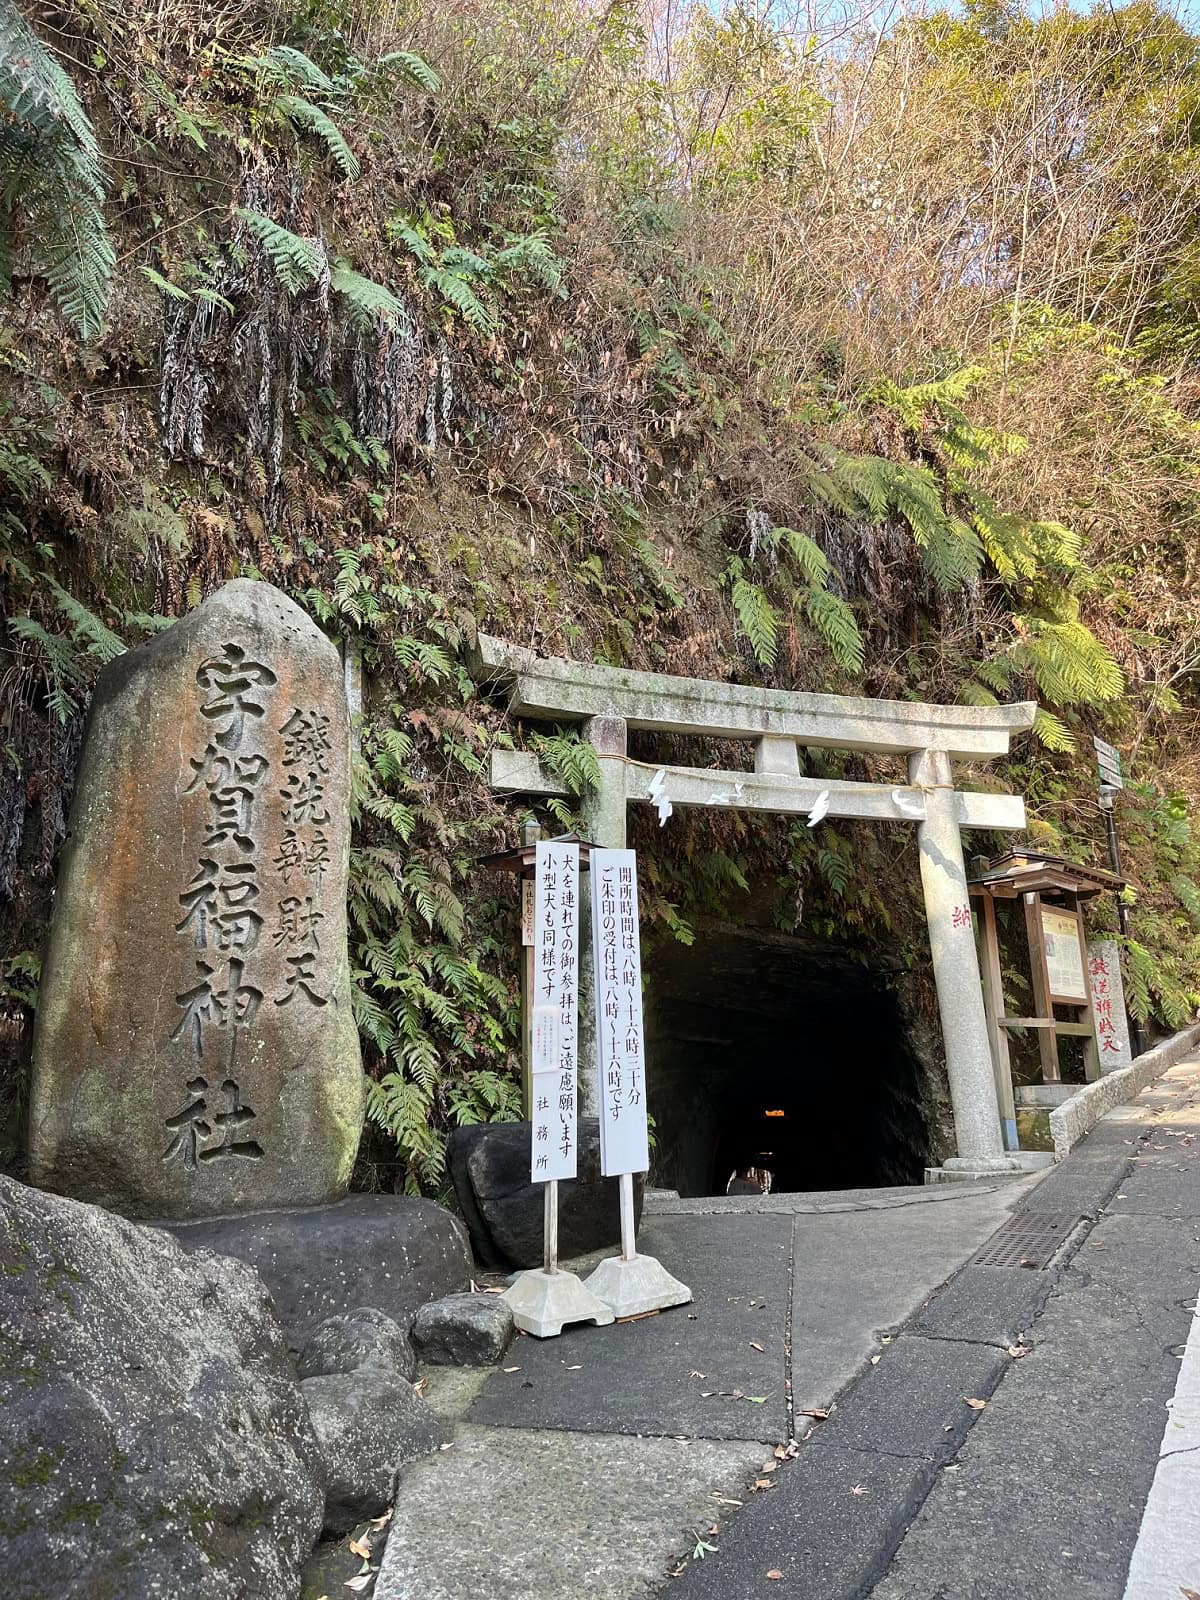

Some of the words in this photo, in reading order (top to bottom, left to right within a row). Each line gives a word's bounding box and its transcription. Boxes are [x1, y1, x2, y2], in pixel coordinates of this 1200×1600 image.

[161, 642, 278, 1170] 宇賀福神社
[541, 853, 557, 999] 小型犬も同様です
[559, 854, 575, 1158] 犬を連れての御参拝は、ご遠慮願います
[536, 1096, 550, 1170] 社務所
